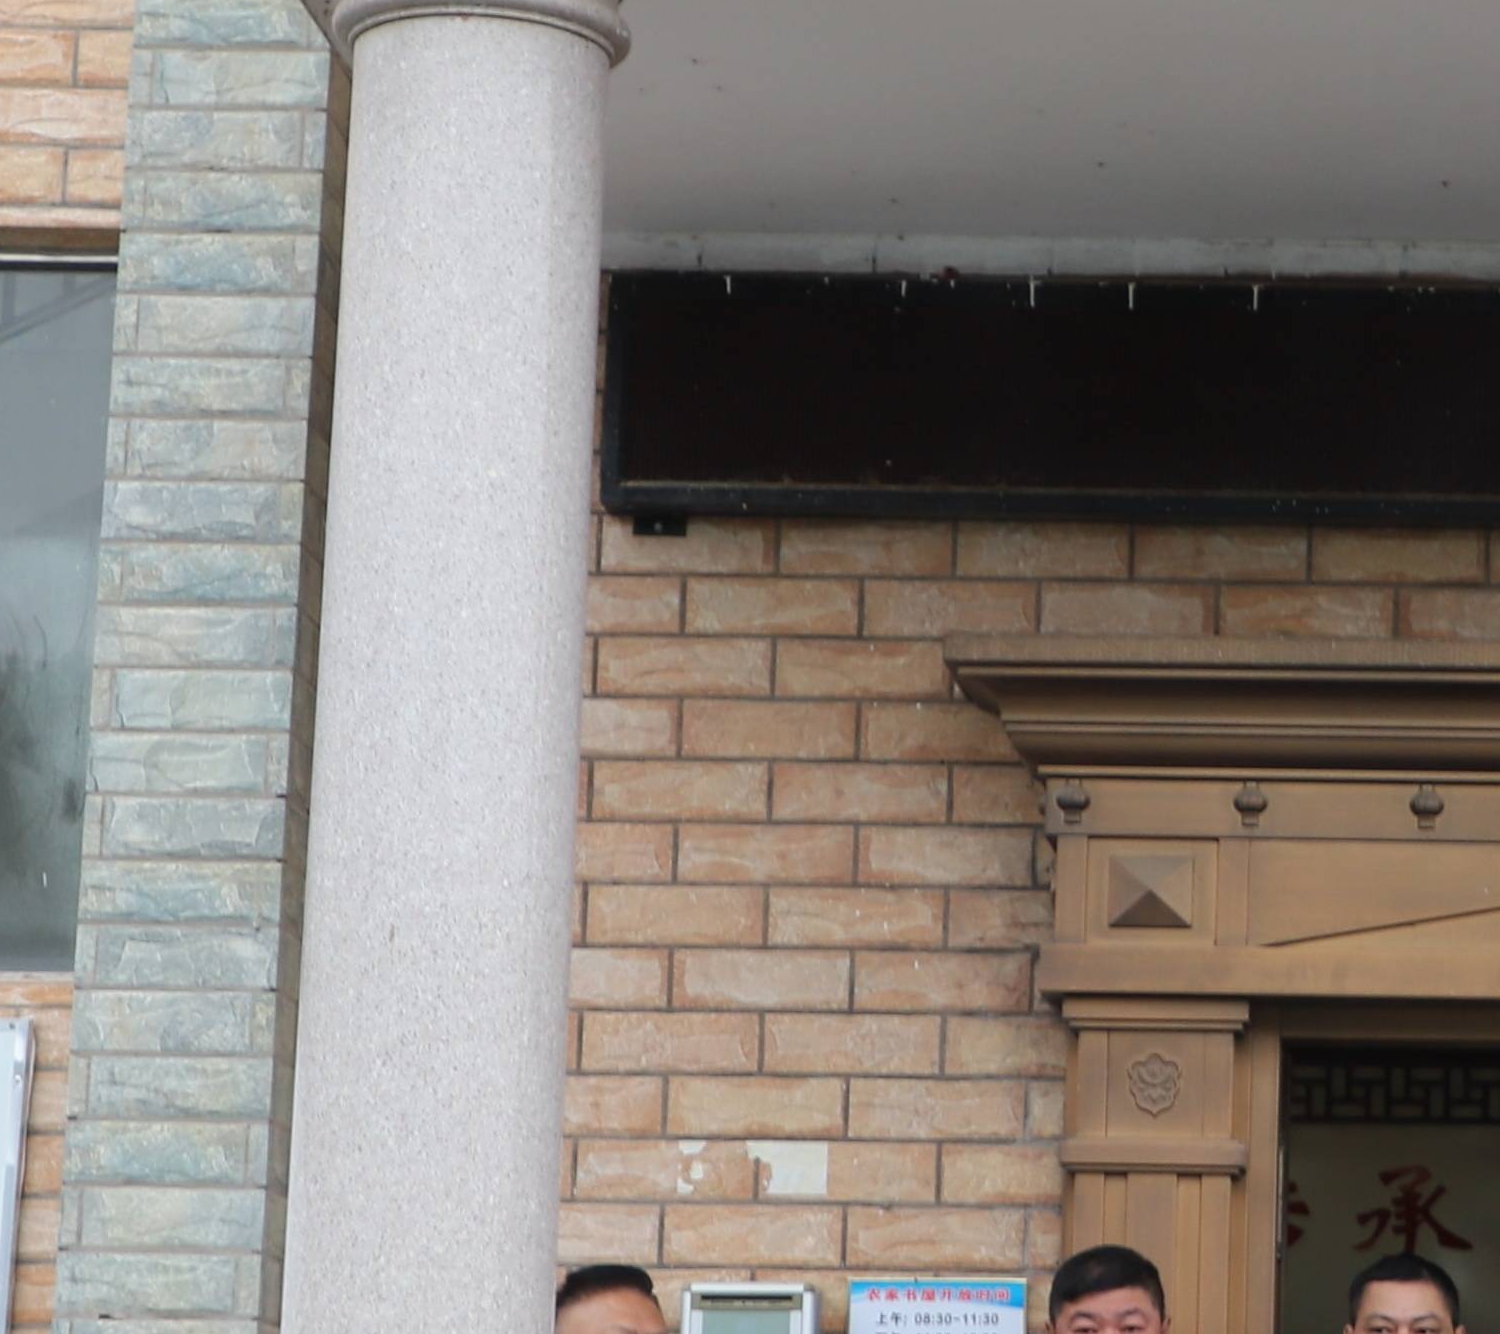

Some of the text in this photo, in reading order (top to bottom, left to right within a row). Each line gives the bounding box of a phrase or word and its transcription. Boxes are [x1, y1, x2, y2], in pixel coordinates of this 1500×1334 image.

[867, 1287, 1011, 1303] 农家书屋开放时间
